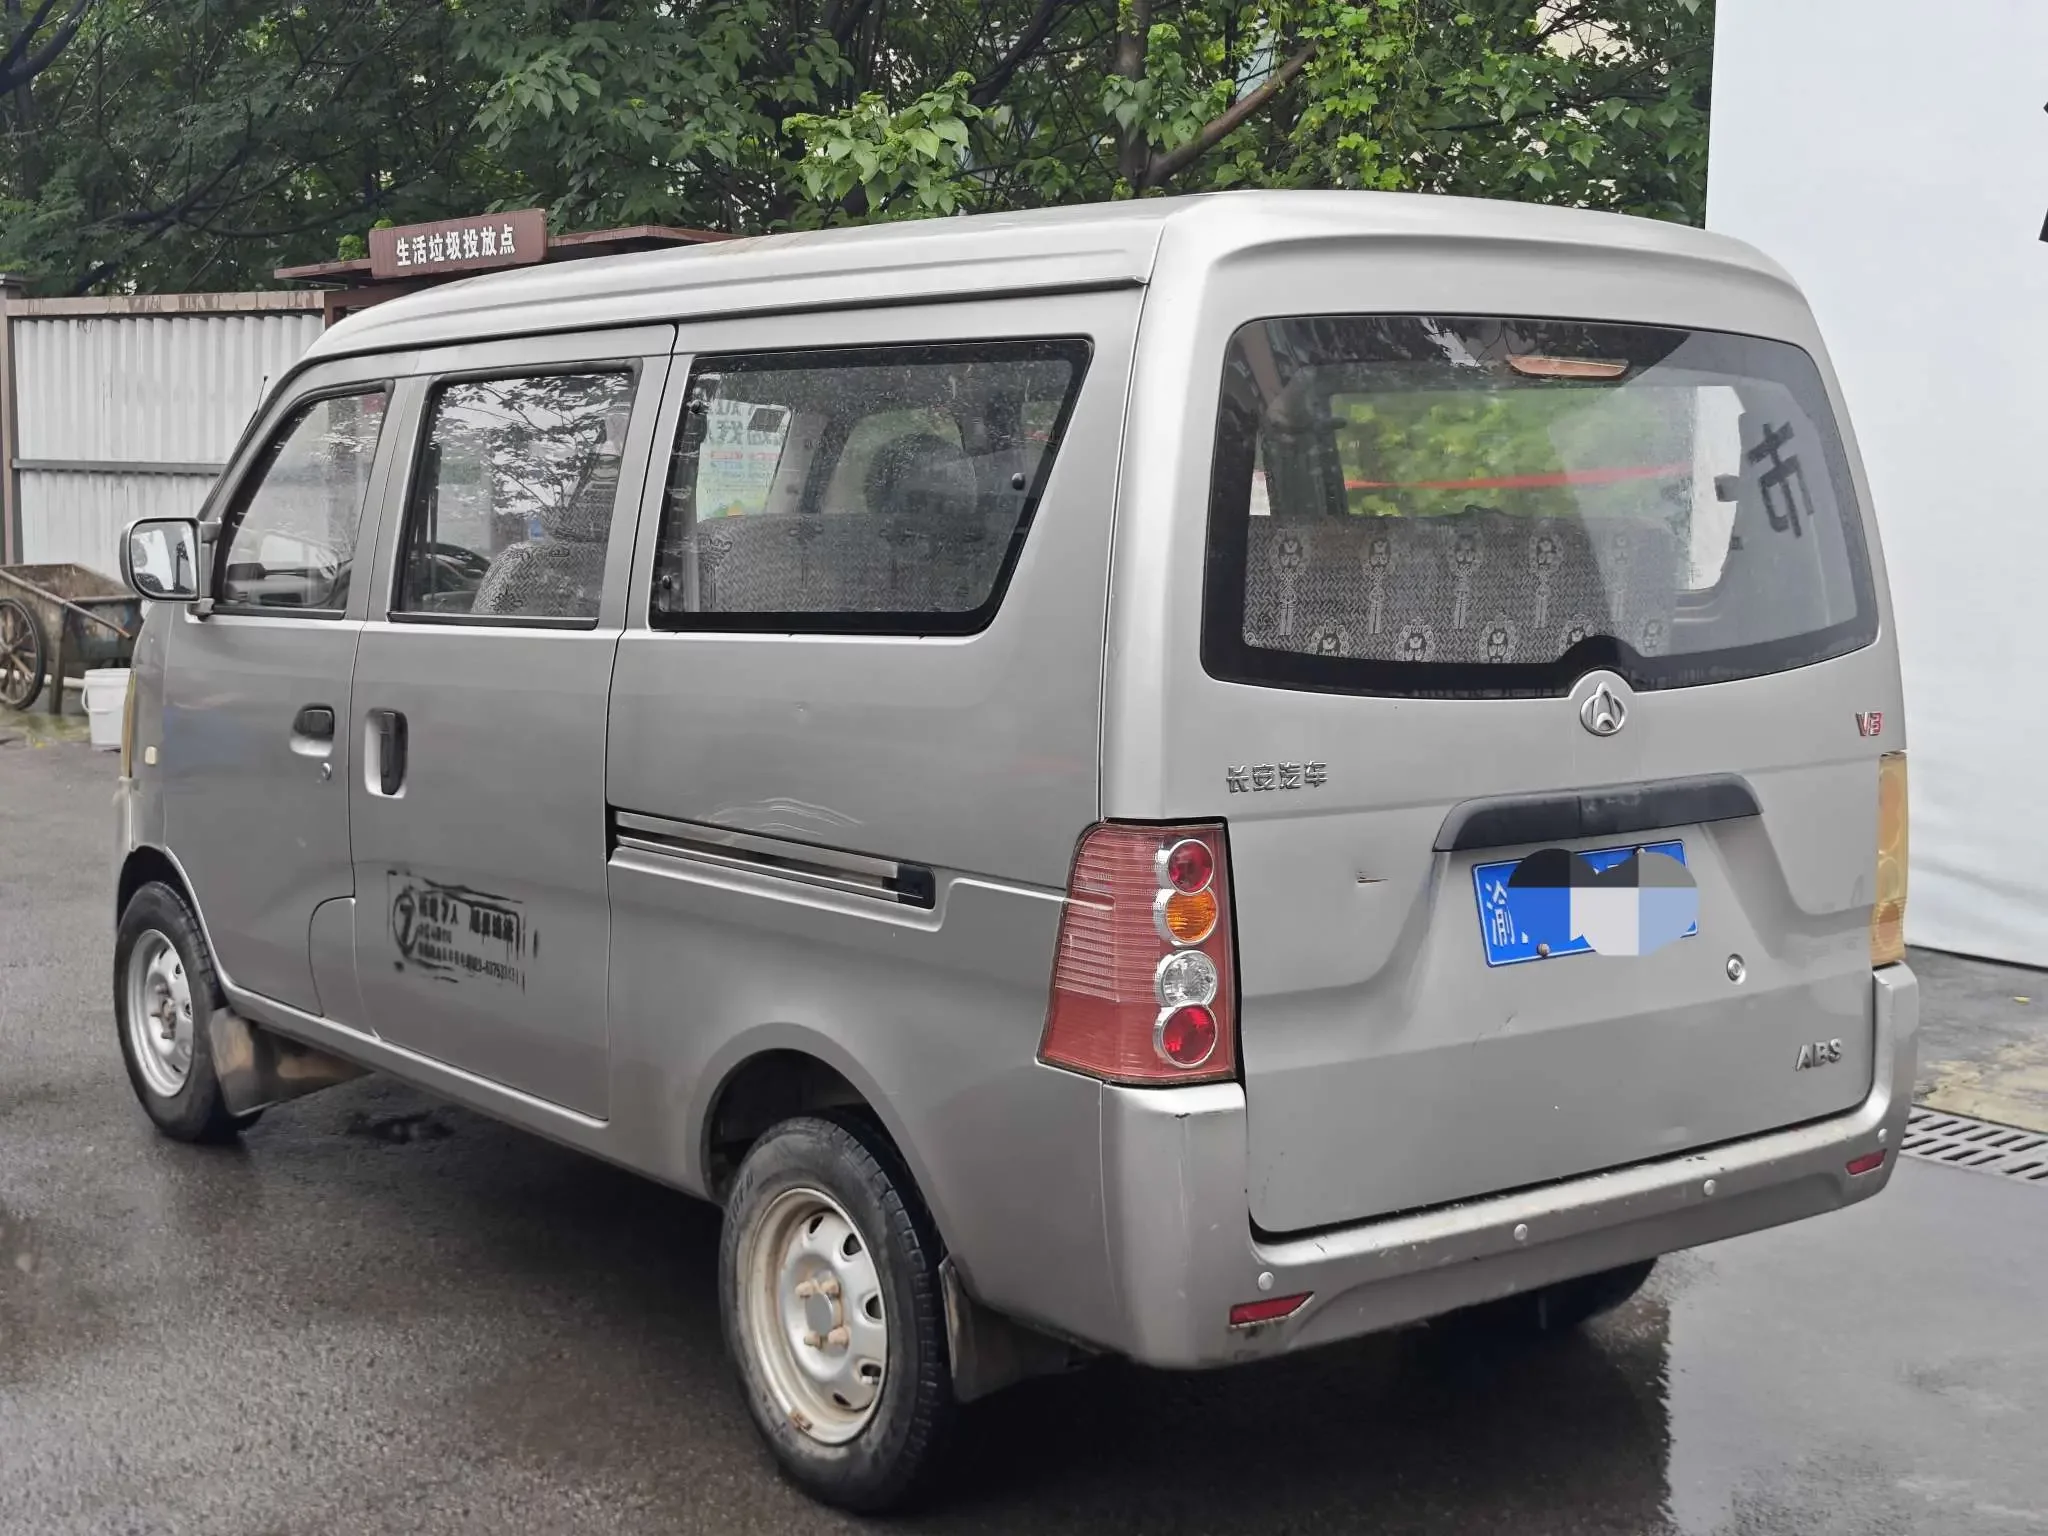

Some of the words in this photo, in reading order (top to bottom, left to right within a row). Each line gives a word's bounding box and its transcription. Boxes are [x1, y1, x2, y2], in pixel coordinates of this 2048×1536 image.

[396, 223, 516, 266] 生活垃圾投放点
[1225, 760, 1328, 793] 长安汽车
[1795, 1038, 1842, 1072] ABS
